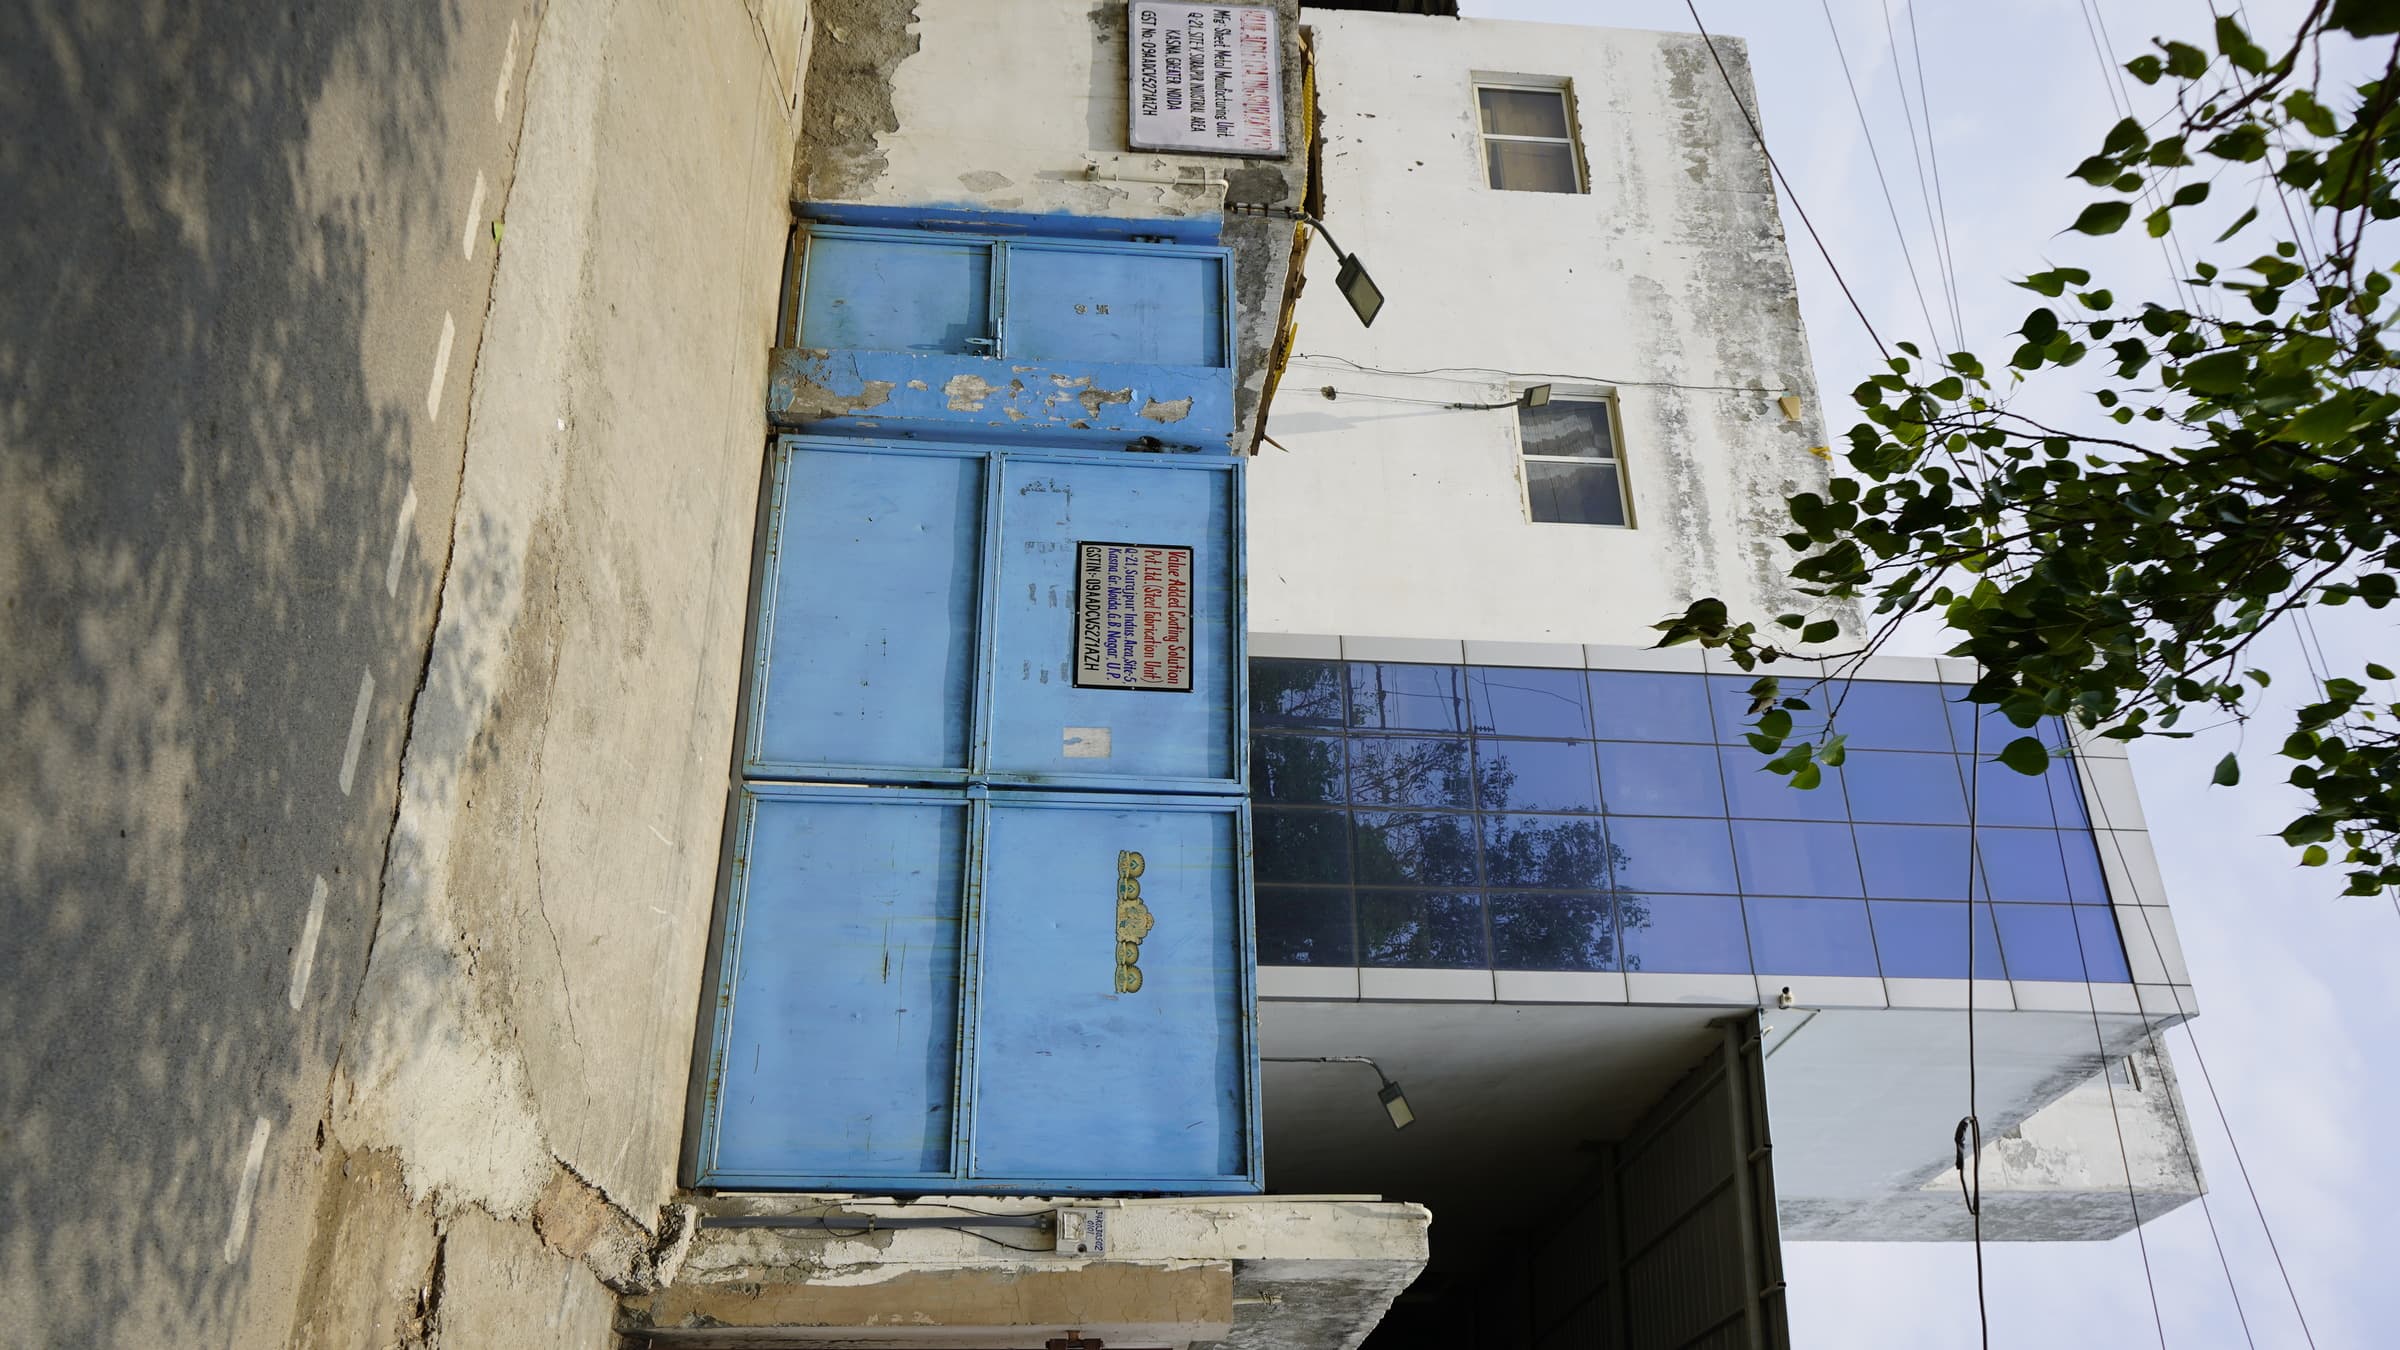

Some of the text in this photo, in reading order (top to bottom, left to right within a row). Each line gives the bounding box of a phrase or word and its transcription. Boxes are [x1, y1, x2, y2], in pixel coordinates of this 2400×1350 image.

[1142, 11, 1156, 25] GST
[1214, 28, 1232, 47] Sheet
[1215, 50, 1232, 69] Metal
[1165, 58, 1181, 84] GREATER
[1167, 88, 1182, 110] NOIDA
[1190, 83, 1205, 114] INDUSTRIAL
[1215, 71, 1233, 119] Manufacturing
[1190, 116, 1206, 132] AREA
[1216, 122, 1234, 137] Unit
[1162, 551, 1186, 684] Value Added Coating Solution
[1144, 611, 1162, 658] Fabrication
[1106, 662, 1120, 681] U.P.
[1141, 661, 1164, 684] Unit)
